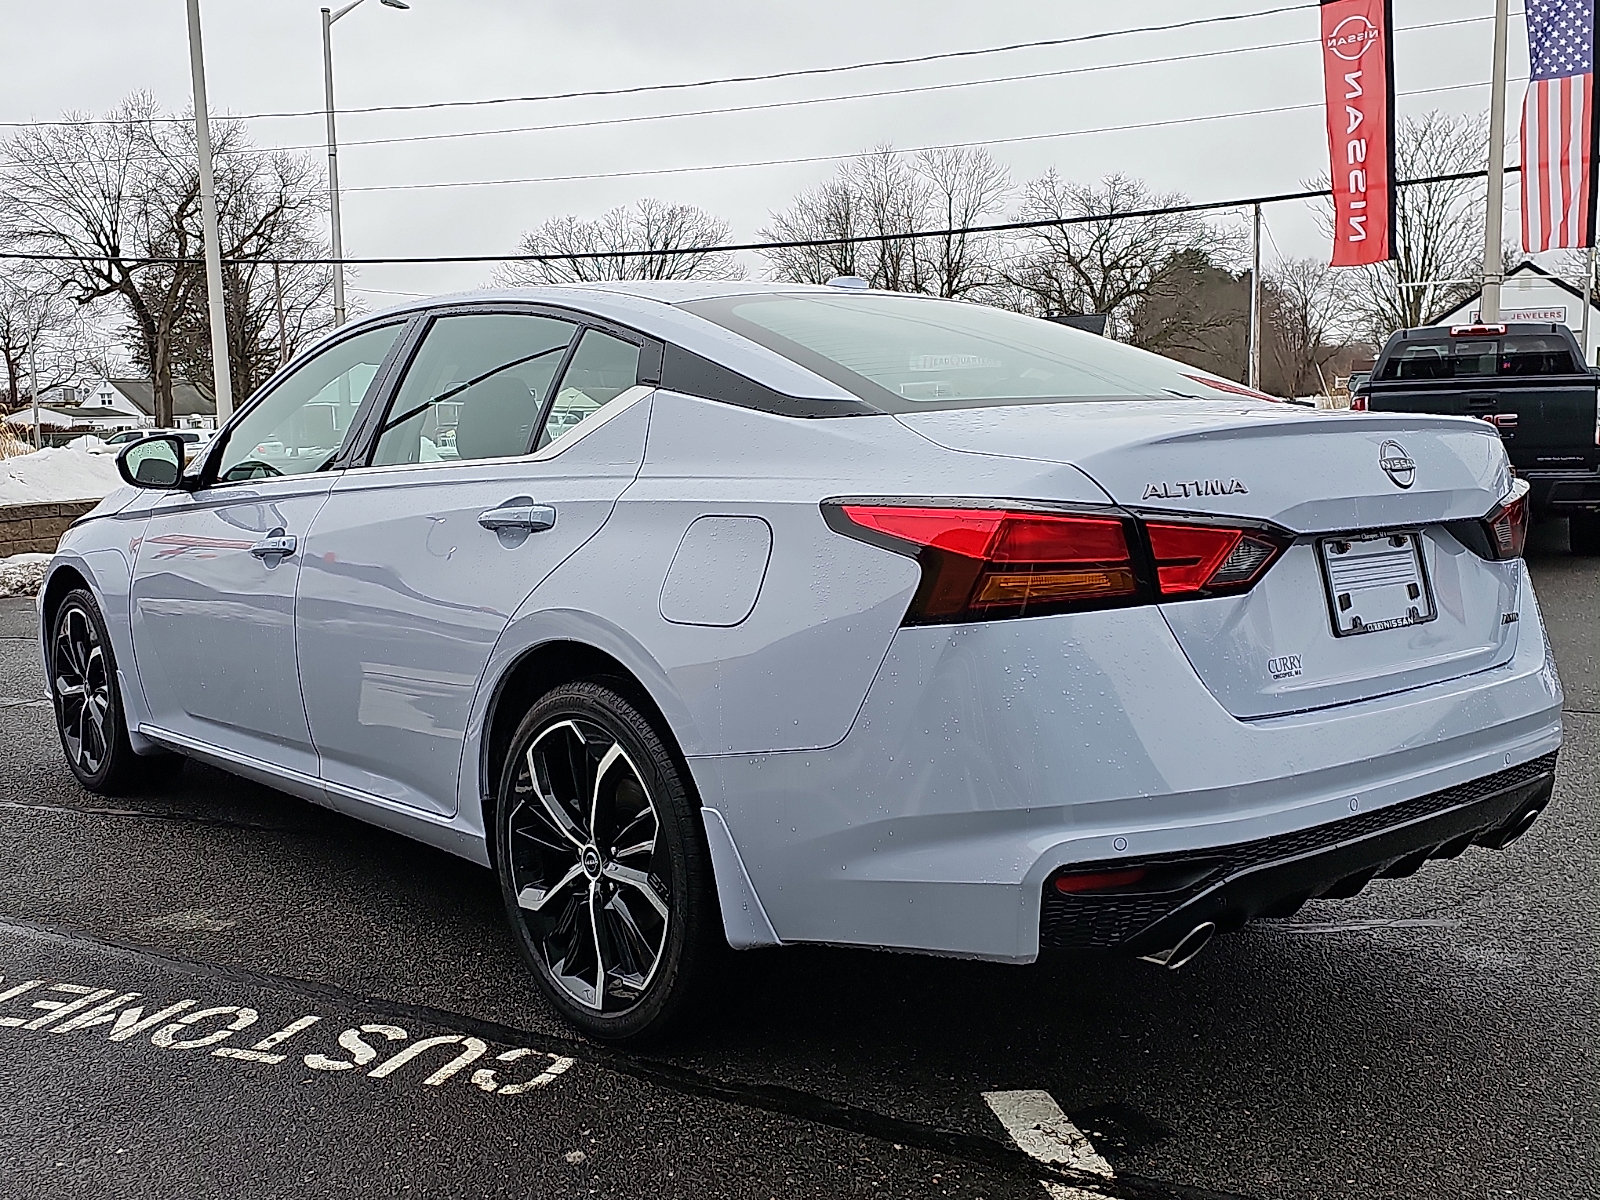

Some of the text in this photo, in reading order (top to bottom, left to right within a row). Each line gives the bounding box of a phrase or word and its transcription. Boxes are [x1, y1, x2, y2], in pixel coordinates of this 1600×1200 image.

[1511, 311, 1562, 320] JEWELERS
[1142, 479, 1249, 500] ALTIMA
[1268, 654, 1302, 673] CURRY
